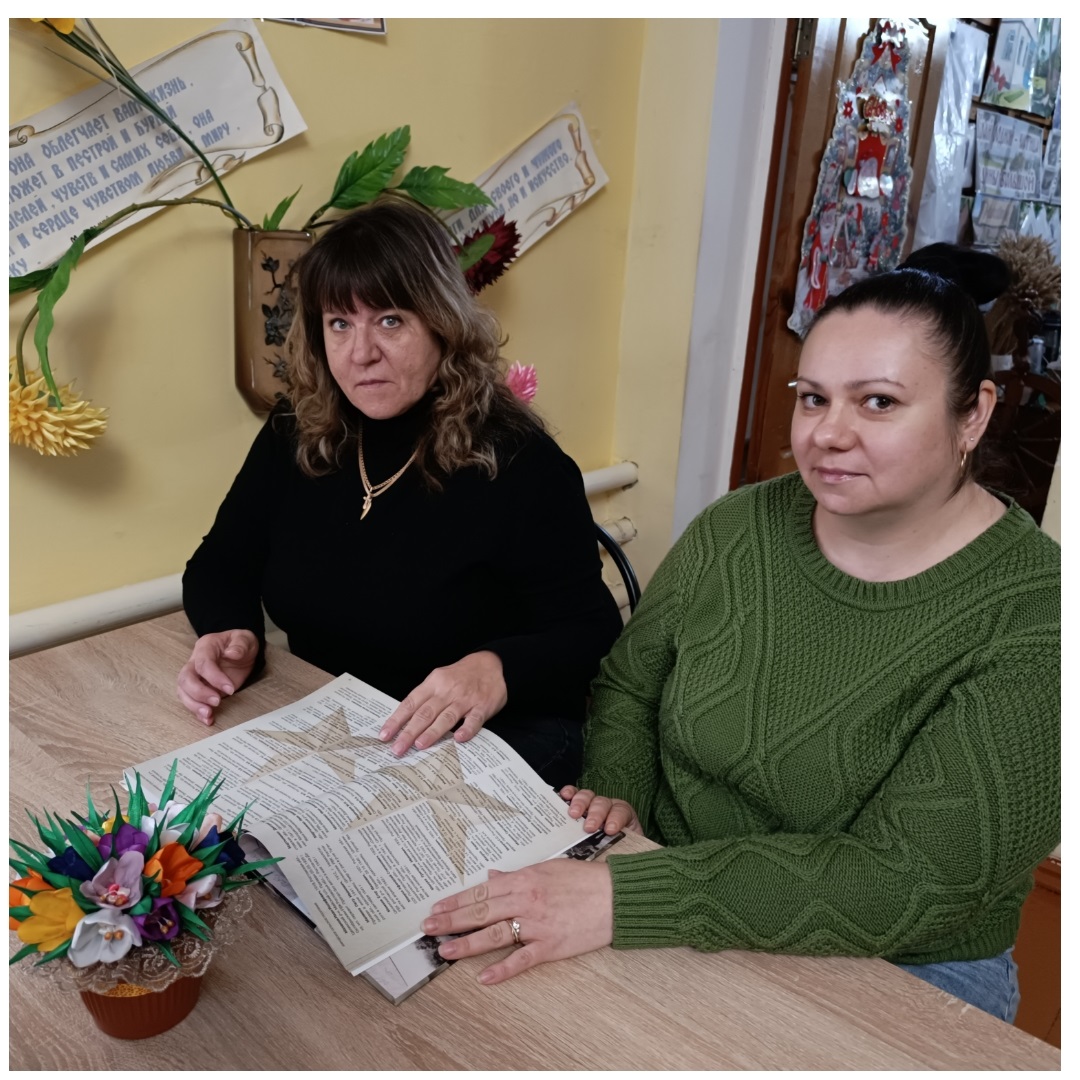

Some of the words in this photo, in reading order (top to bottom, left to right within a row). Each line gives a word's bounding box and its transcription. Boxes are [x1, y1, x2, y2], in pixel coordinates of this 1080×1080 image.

[41, 114, 110, 159] ОБЛЕГЧАЕТ
[112, 100, 143, 123] ВАМ
[51, 163, 64, 179] В
[66, 132, 118, 172] ПЕСТРОЙ
[120, 128, 132, 144] И
[134, 101, 178, 137] БУРЙ
[51, 172, 98, 203] ЧУВСТВ
[98, 164, 110, 180] И
[110, 142, 152, 173] САМИХ
[192, 108, 214, 129] ОНА
[16, 232, 30, 249] И
[32, 205, 80, 240] СЕРДЦЕ
[82, 171, 144, 211] ЧУВСТВОМ
[146, 146, 186, 178] ЛЮБВИ
[490, 172, 521, 203] СВОЕГО
[521, 165, 530, 178] И
[519, 186, 528, 199] И
